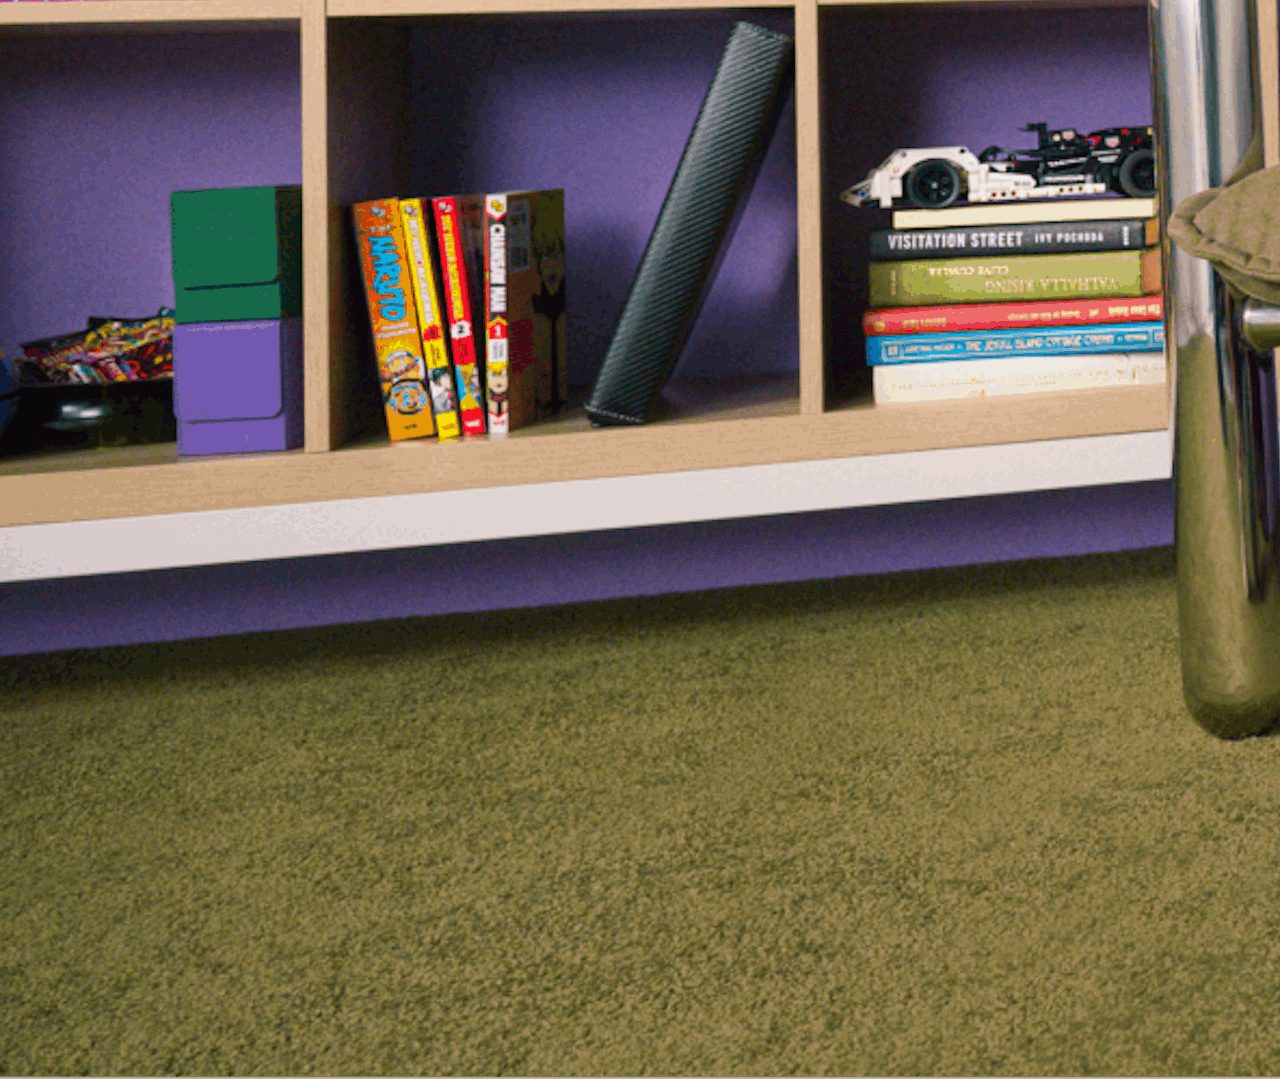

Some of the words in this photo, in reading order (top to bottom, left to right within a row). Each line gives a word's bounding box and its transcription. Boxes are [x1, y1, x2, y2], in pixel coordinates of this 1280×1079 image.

[887, 231, 966, 250] VISITATION
[969, 230, 1025, 248] STREET
[367, 234, 407, 321] NARUTO
[984, 277, 1035, 294] RISING
[1039, 276, 1118, 292] VALHALLA
